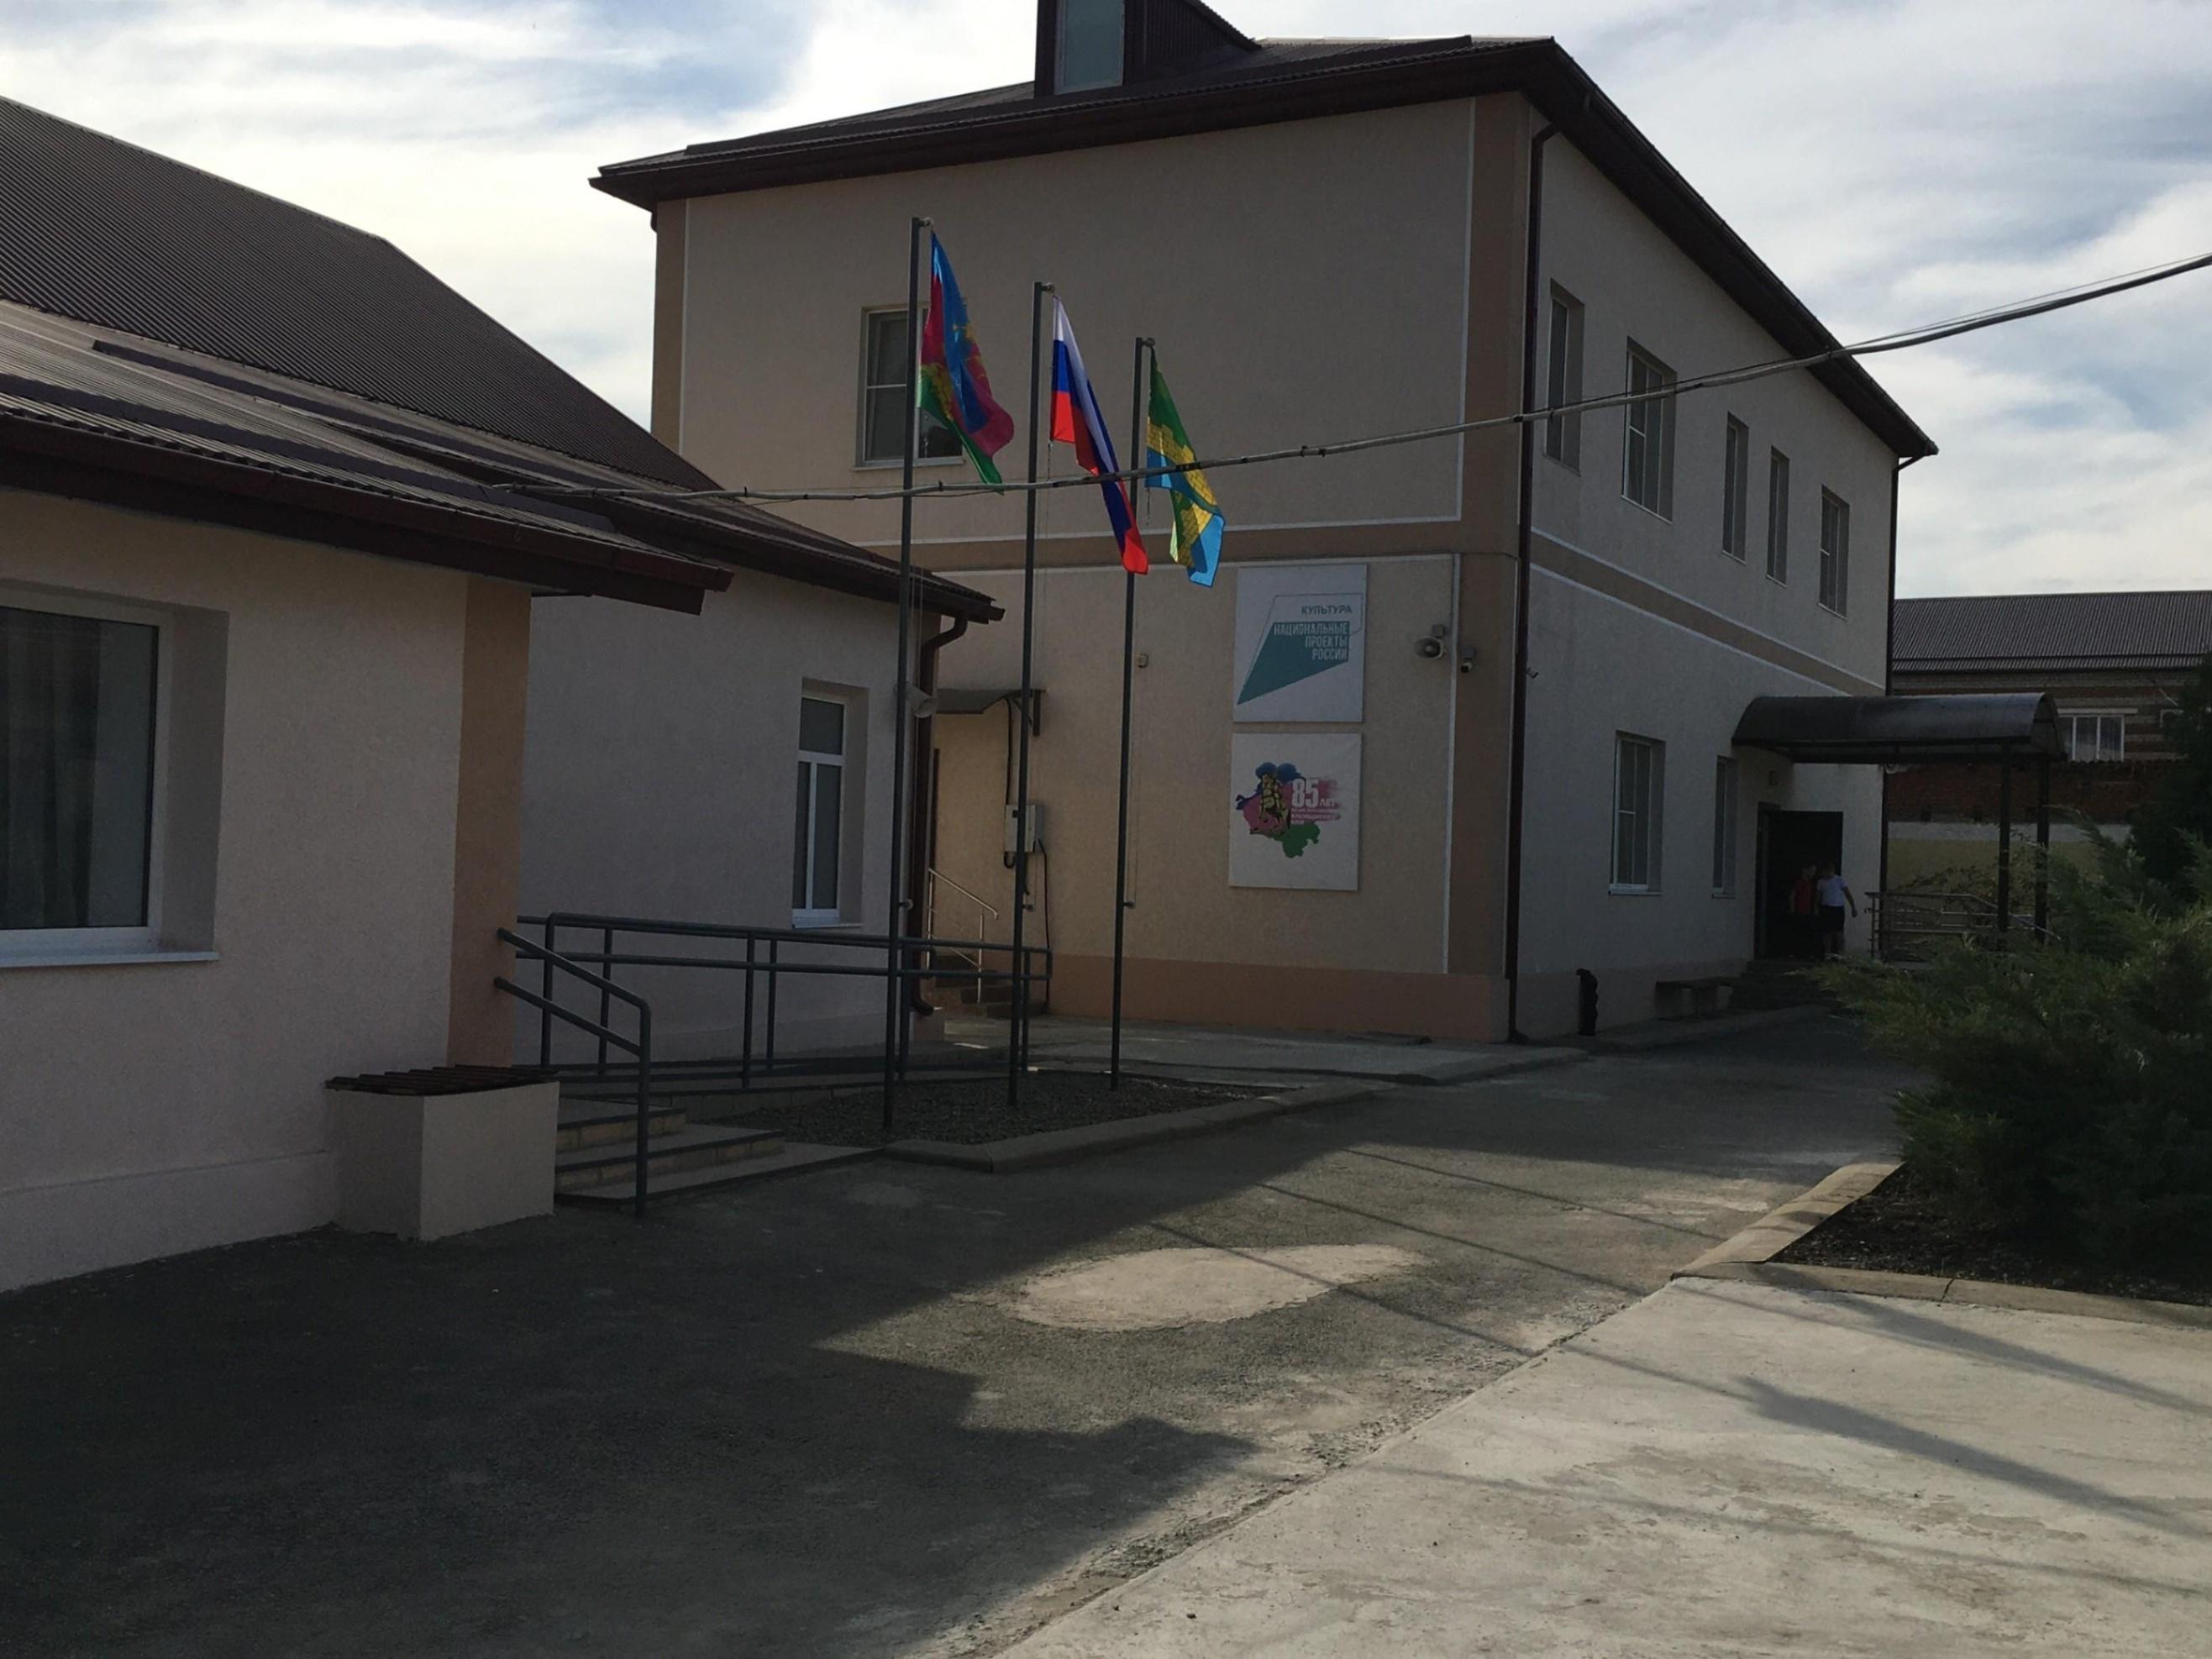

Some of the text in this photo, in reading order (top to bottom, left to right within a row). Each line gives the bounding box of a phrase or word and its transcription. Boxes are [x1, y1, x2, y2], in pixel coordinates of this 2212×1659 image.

[1301, 605, 1353, 614] КУЛЬТУРА
[1274, 622, 1348, 636] НАЦИОНАЛЬНЫЕ
[1306, 635, 1348, 648] ПРОЕКТЫ
[1311, 647, 1348, 660] РОССИИ
[1291, 778, 1336, 807] 85 ЛЕТ
